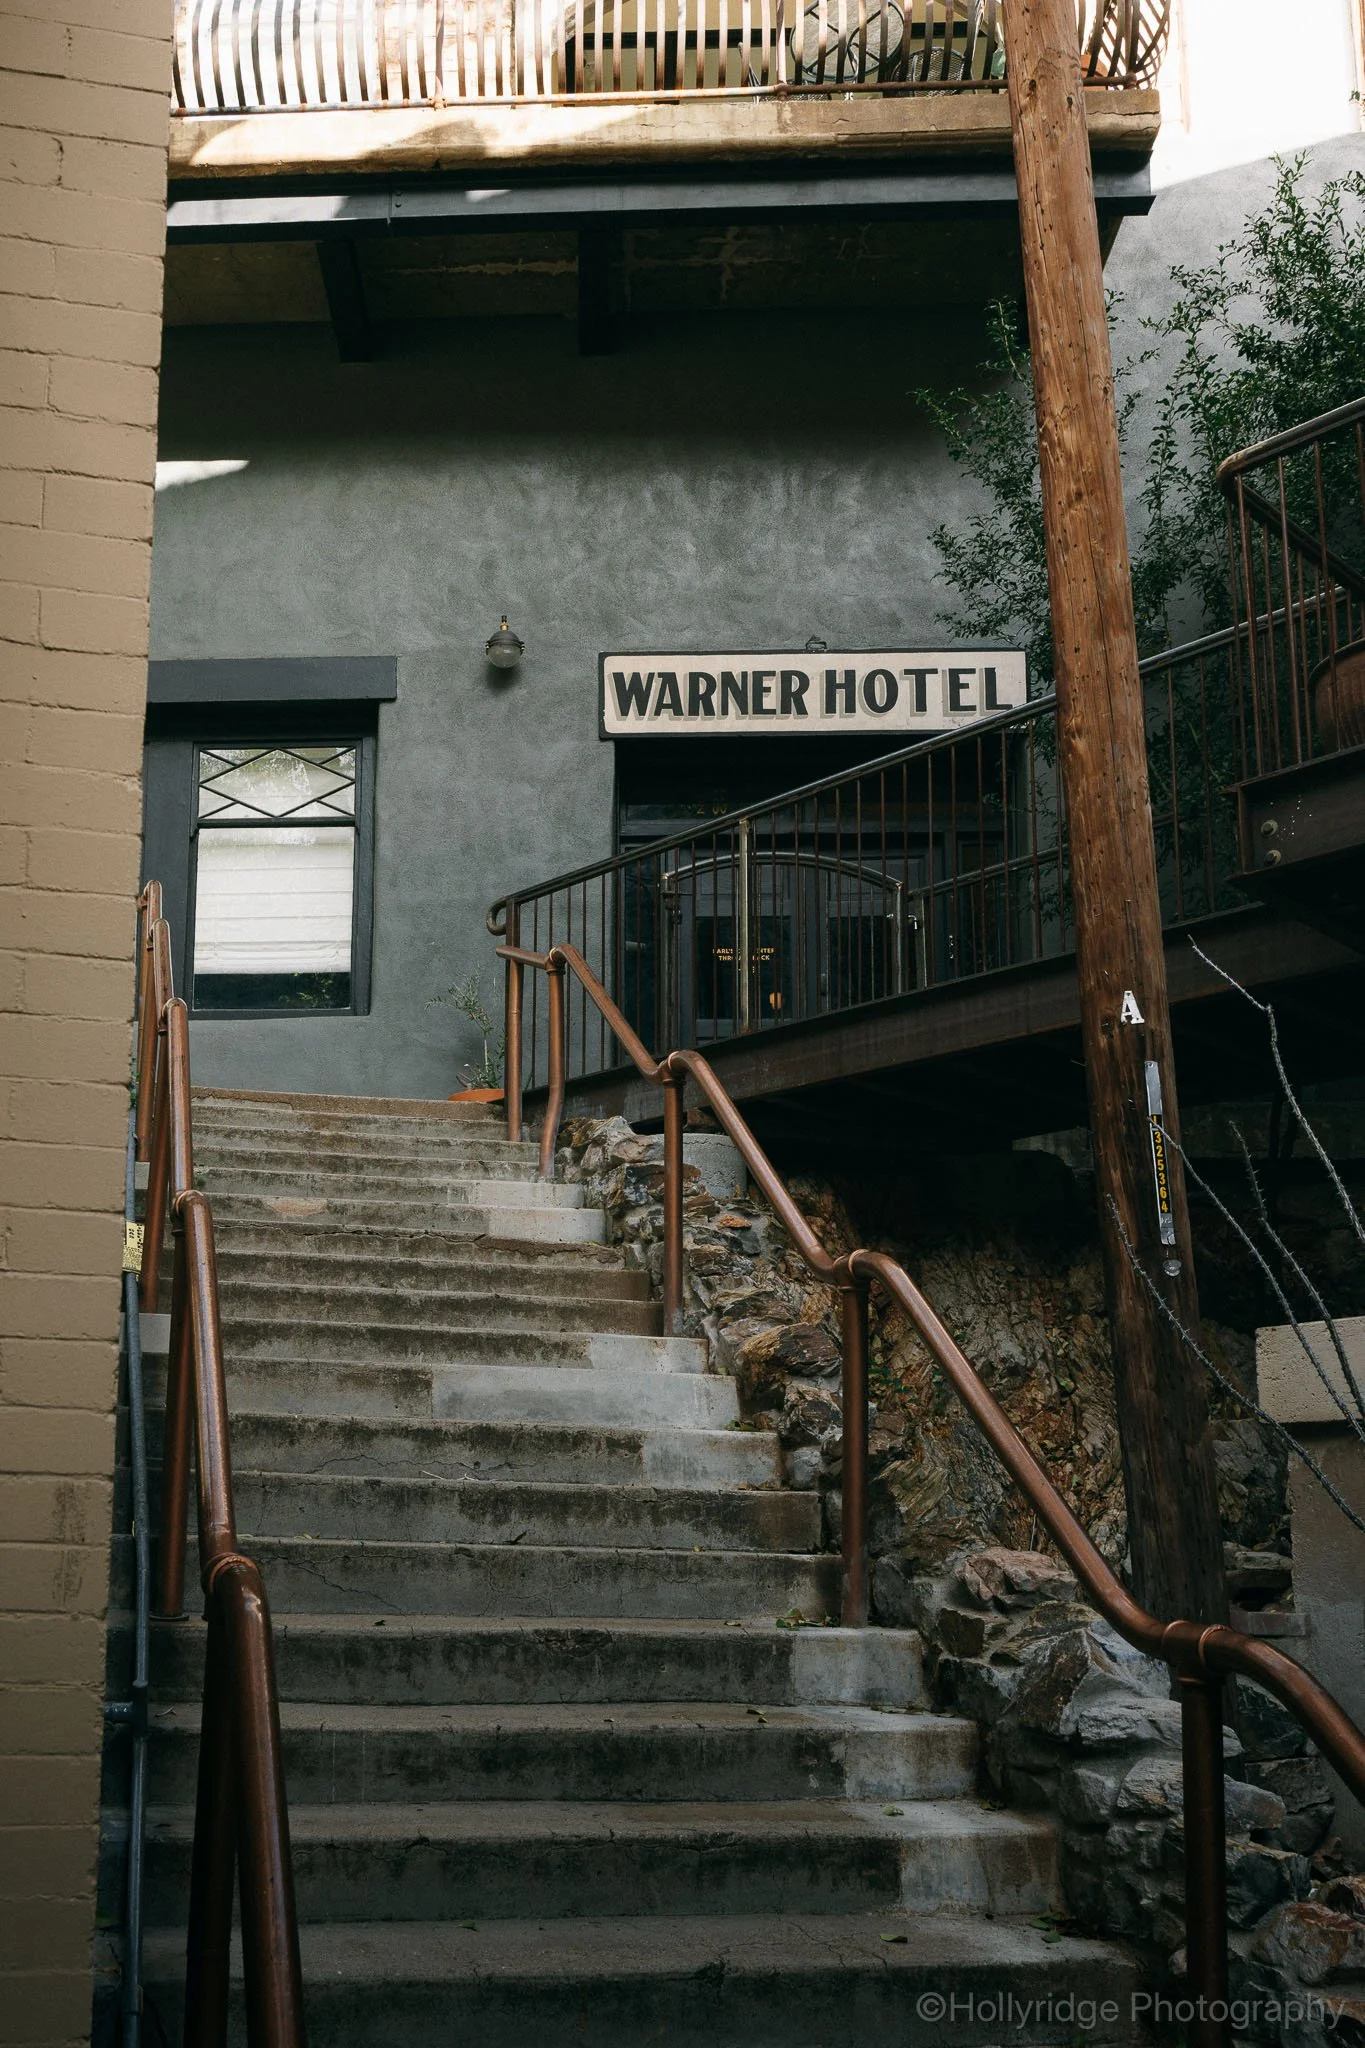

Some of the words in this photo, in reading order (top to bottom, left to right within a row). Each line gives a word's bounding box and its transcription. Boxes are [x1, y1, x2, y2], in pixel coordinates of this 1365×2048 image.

[610, 670, 811, 718] WARNER
[822, 667, 1013, 716] HOTEL
[1120, 990, 1145, 1024] A
